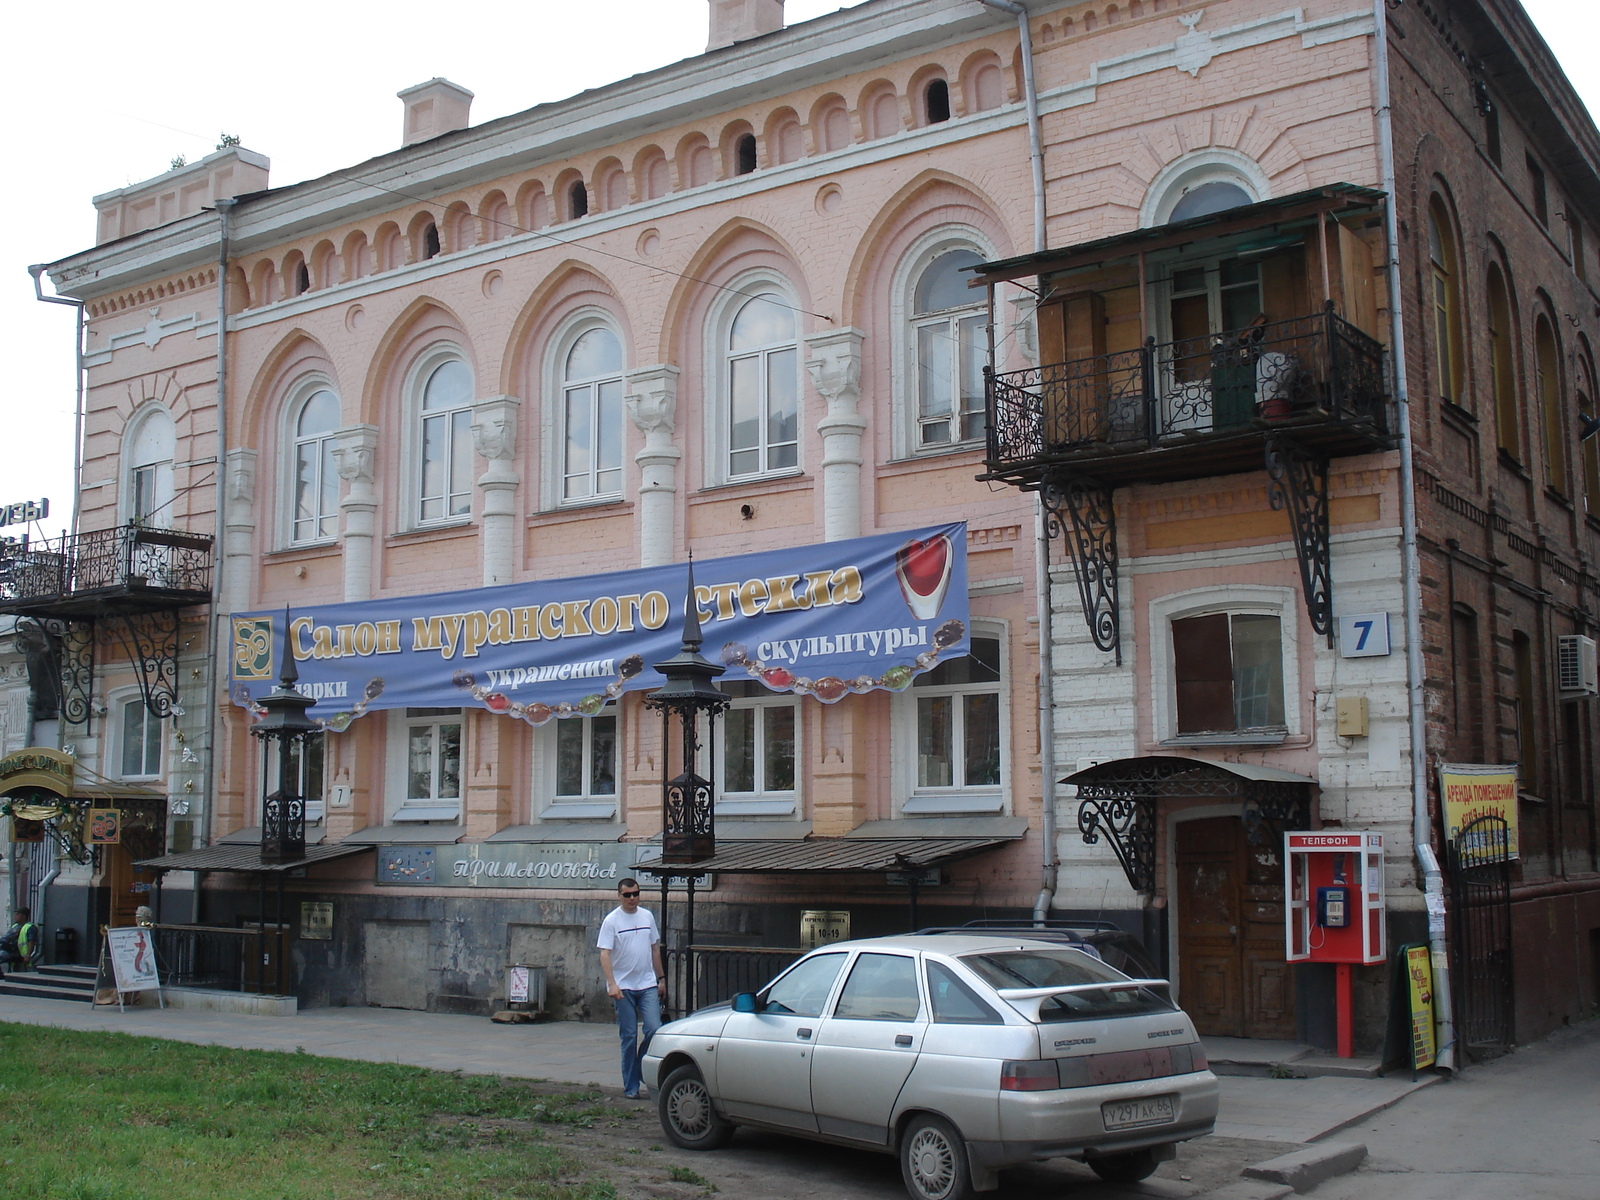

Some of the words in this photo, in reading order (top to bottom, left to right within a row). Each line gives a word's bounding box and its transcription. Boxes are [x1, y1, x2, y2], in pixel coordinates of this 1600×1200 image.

[290, 616, 402, 662] Салон
[412, 590, 670, 660] муранского
[684, 565, 863, 625] стекла
[757, 625, 928, 665] скульптуры
[1353, 620, 1374, 651] 7
[486, 658, 616, 692] украшения
[271, 681, 348, 702] пдарки
[25, 753, 68, 779] CAPITAL
[338, 788, 343, 803] 7
[1447, 784, 1473, 806] АРЕНДА
[1474, 780, 1515, 803] ПОМЕЩЕНИЙ
[1302, 837, 1348, 845] ТЕЛЕФОН
[453, 859, 617, 880] ПРИМАДОННА
